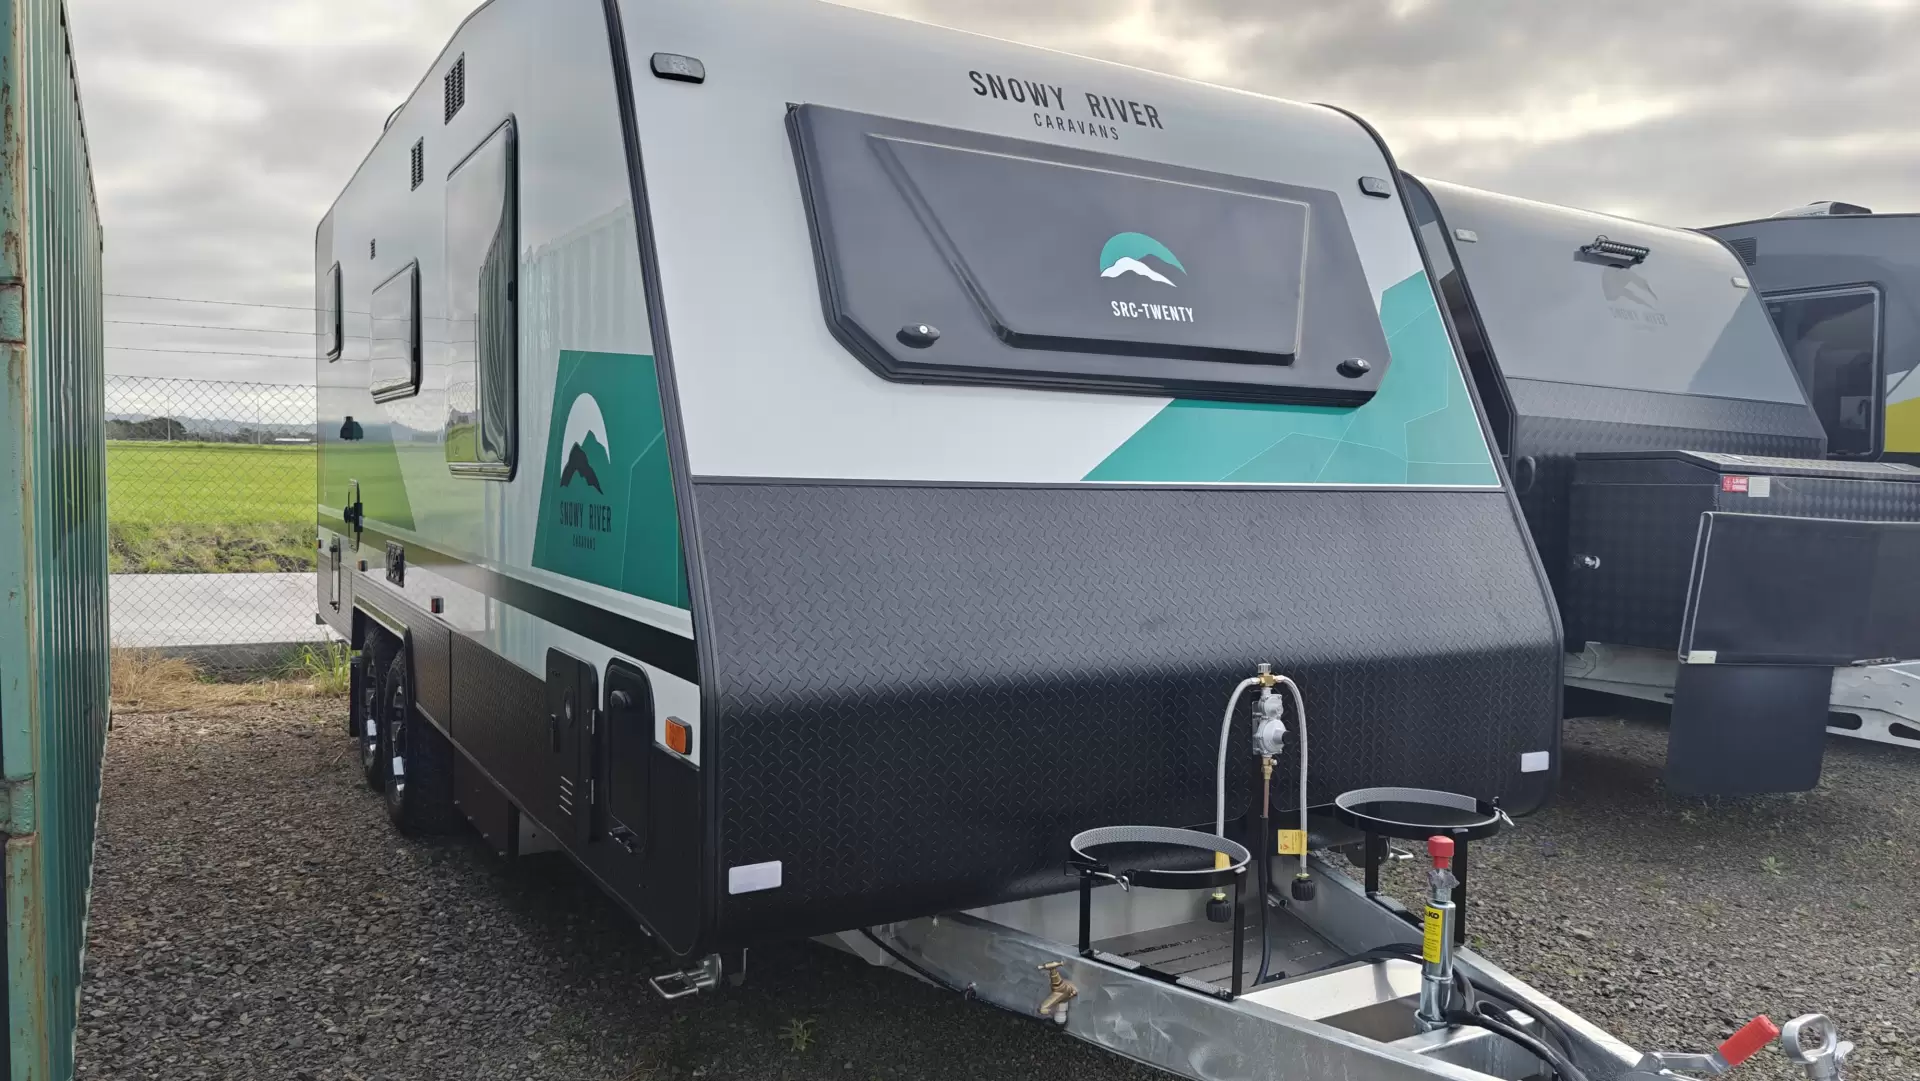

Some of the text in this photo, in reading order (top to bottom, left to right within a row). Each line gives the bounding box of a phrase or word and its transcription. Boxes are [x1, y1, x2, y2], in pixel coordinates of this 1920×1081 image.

[968, 70, 1164, 129] SNOWY RIVER
[1033, 112, 1119, 140] CARAVANS
[1111, 301, 1194, 322] SRC-TWENTY
[560, 501, 612, 532] SNOWY RIVER
